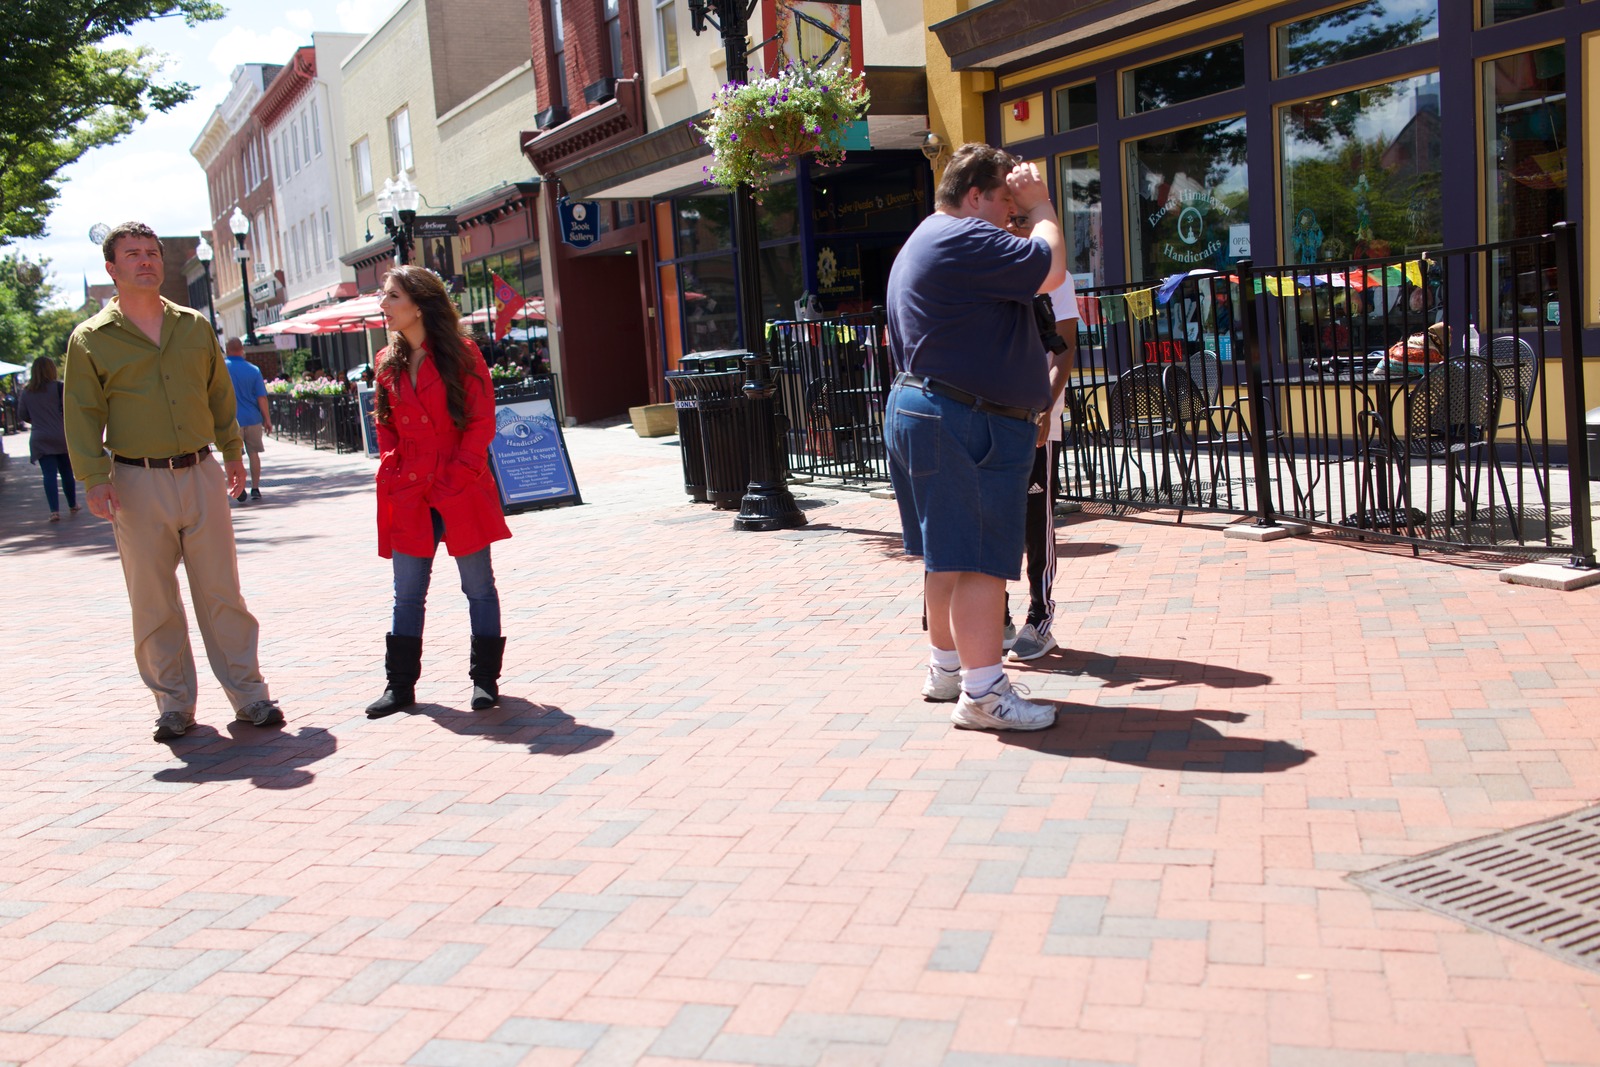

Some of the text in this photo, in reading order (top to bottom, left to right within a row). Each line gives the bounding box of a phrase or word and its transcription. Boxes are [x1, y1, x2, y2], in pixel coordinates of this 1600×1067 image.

[1148, 188, 1231, 228] Exotic Himalayan
[1233, 237, 1250, 246] OPEN
[1163, 239, 1222, 263] Handicrafts
[511, 415, 548, 426] Himalayan
[506, 434, 544, 447] Handicrafts
[498, 446, 556, 458] Handmade Treasures
[540, 452, 557, 460] Nepal
